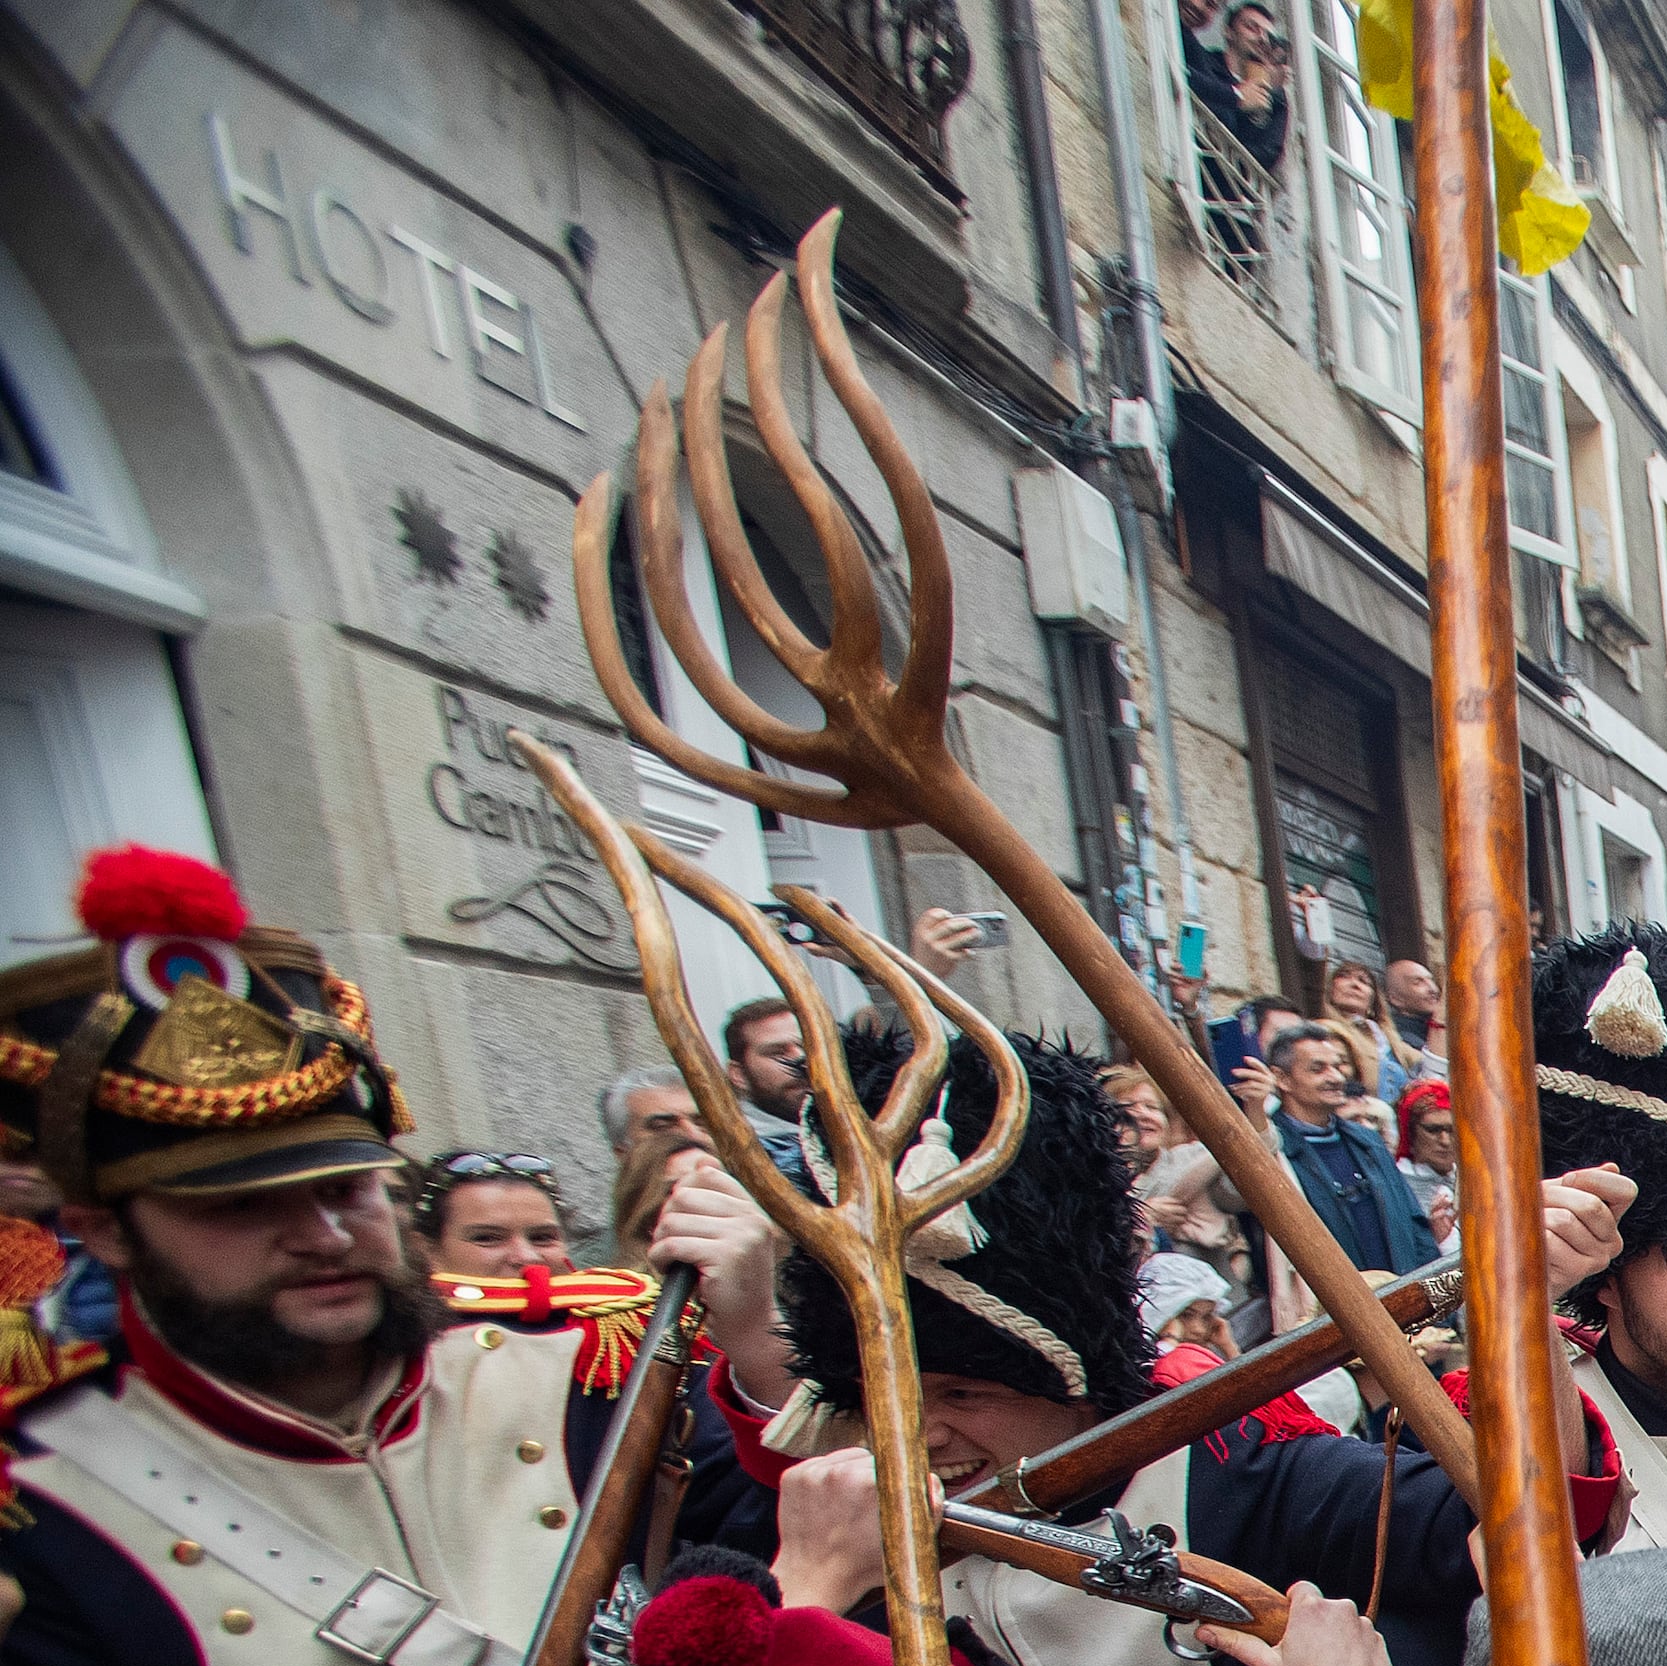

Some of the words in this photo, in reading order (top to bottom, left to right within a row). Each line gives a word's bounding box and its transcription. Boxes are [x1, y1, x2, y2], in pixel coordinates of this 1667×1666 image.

[208, 111, 592, 434] HOTEL
[436, 684, 580, 770] Pue
[430, 762, 600, 862] Gamb
